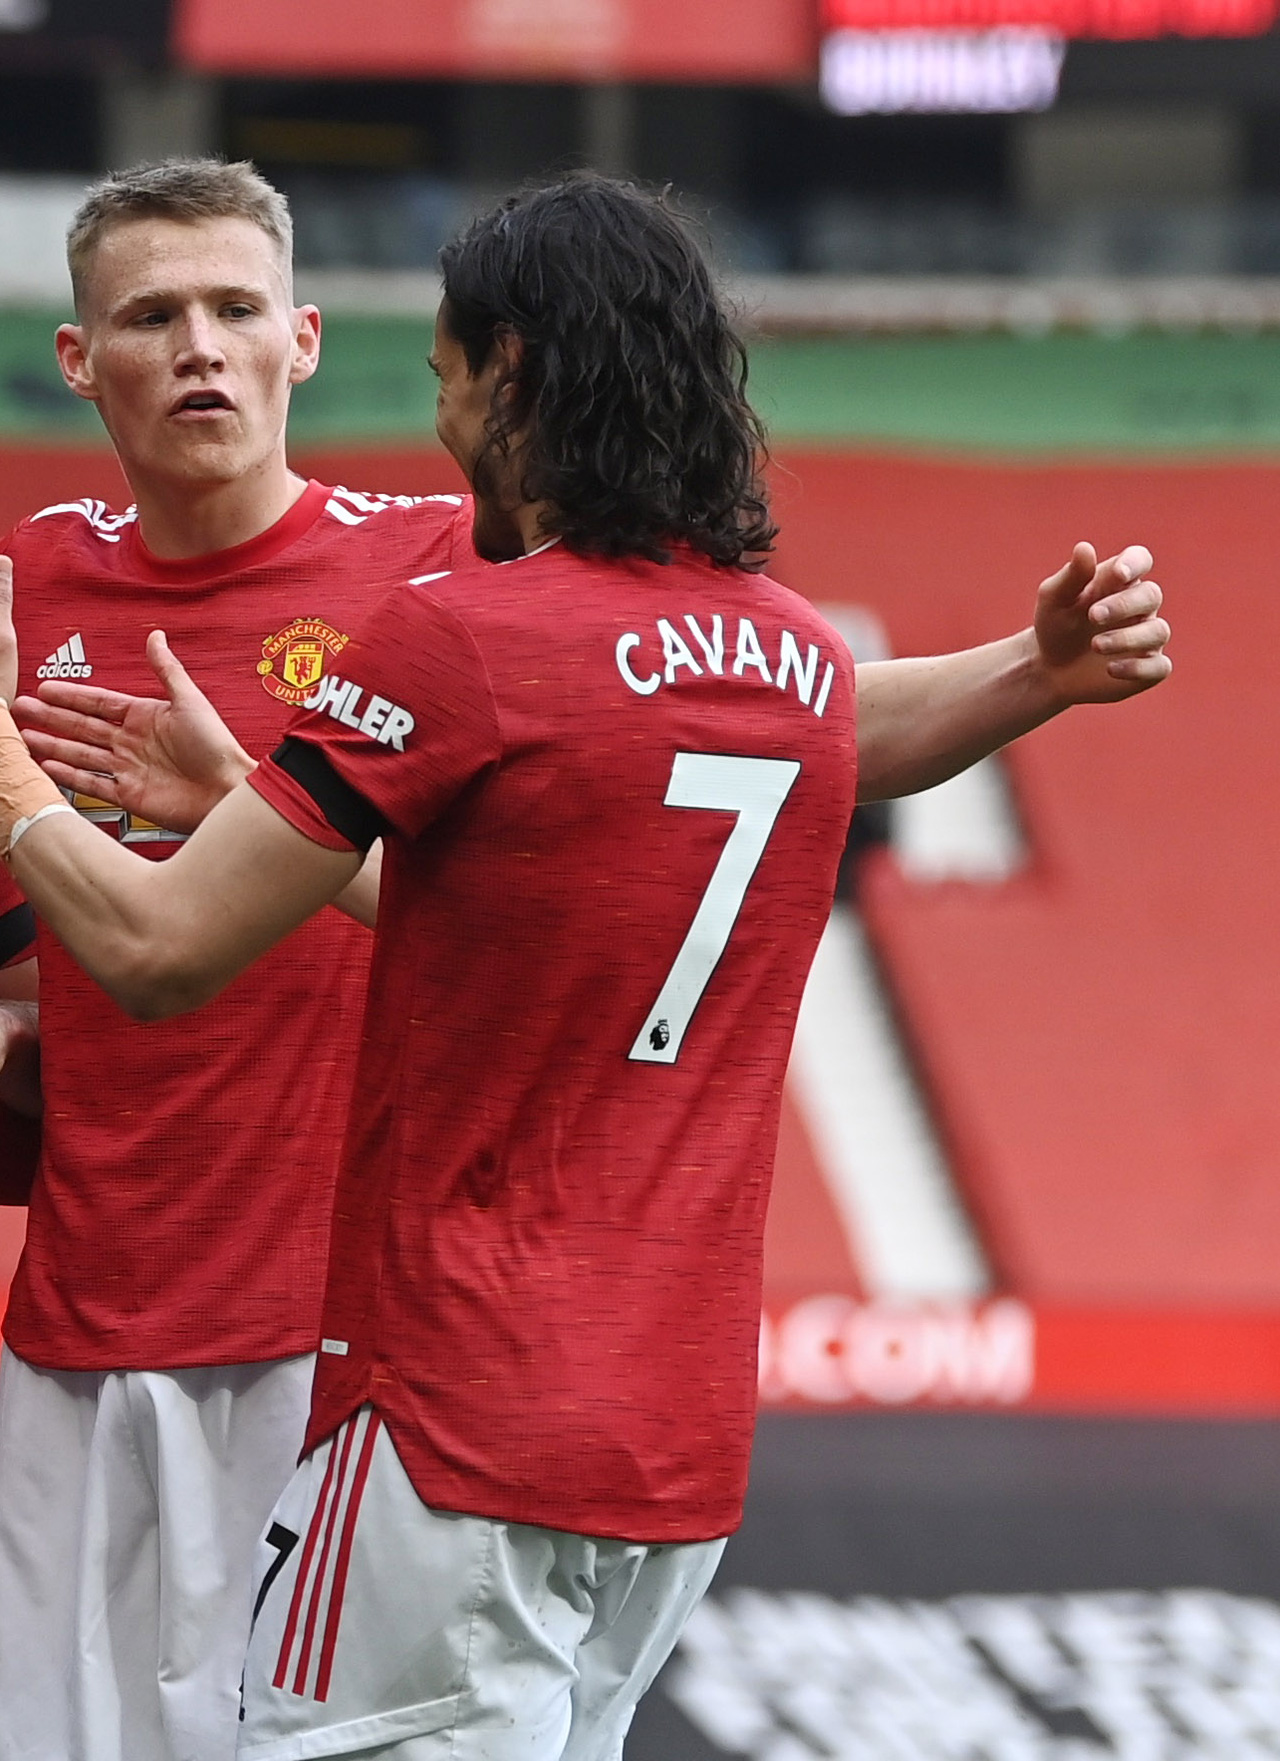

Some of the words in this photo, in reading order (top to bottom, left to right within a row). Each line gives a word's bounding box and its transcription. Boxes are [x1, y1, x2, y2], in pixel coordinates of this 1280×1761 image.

[268, 623, 344, 653] MANCHESTER
[36, 660, 93, 679] adidas
[616, 614, 834, 717] CAVANI
[275, 684, 315, 700] UNIT
[627, 751, 802, 1064] 7
